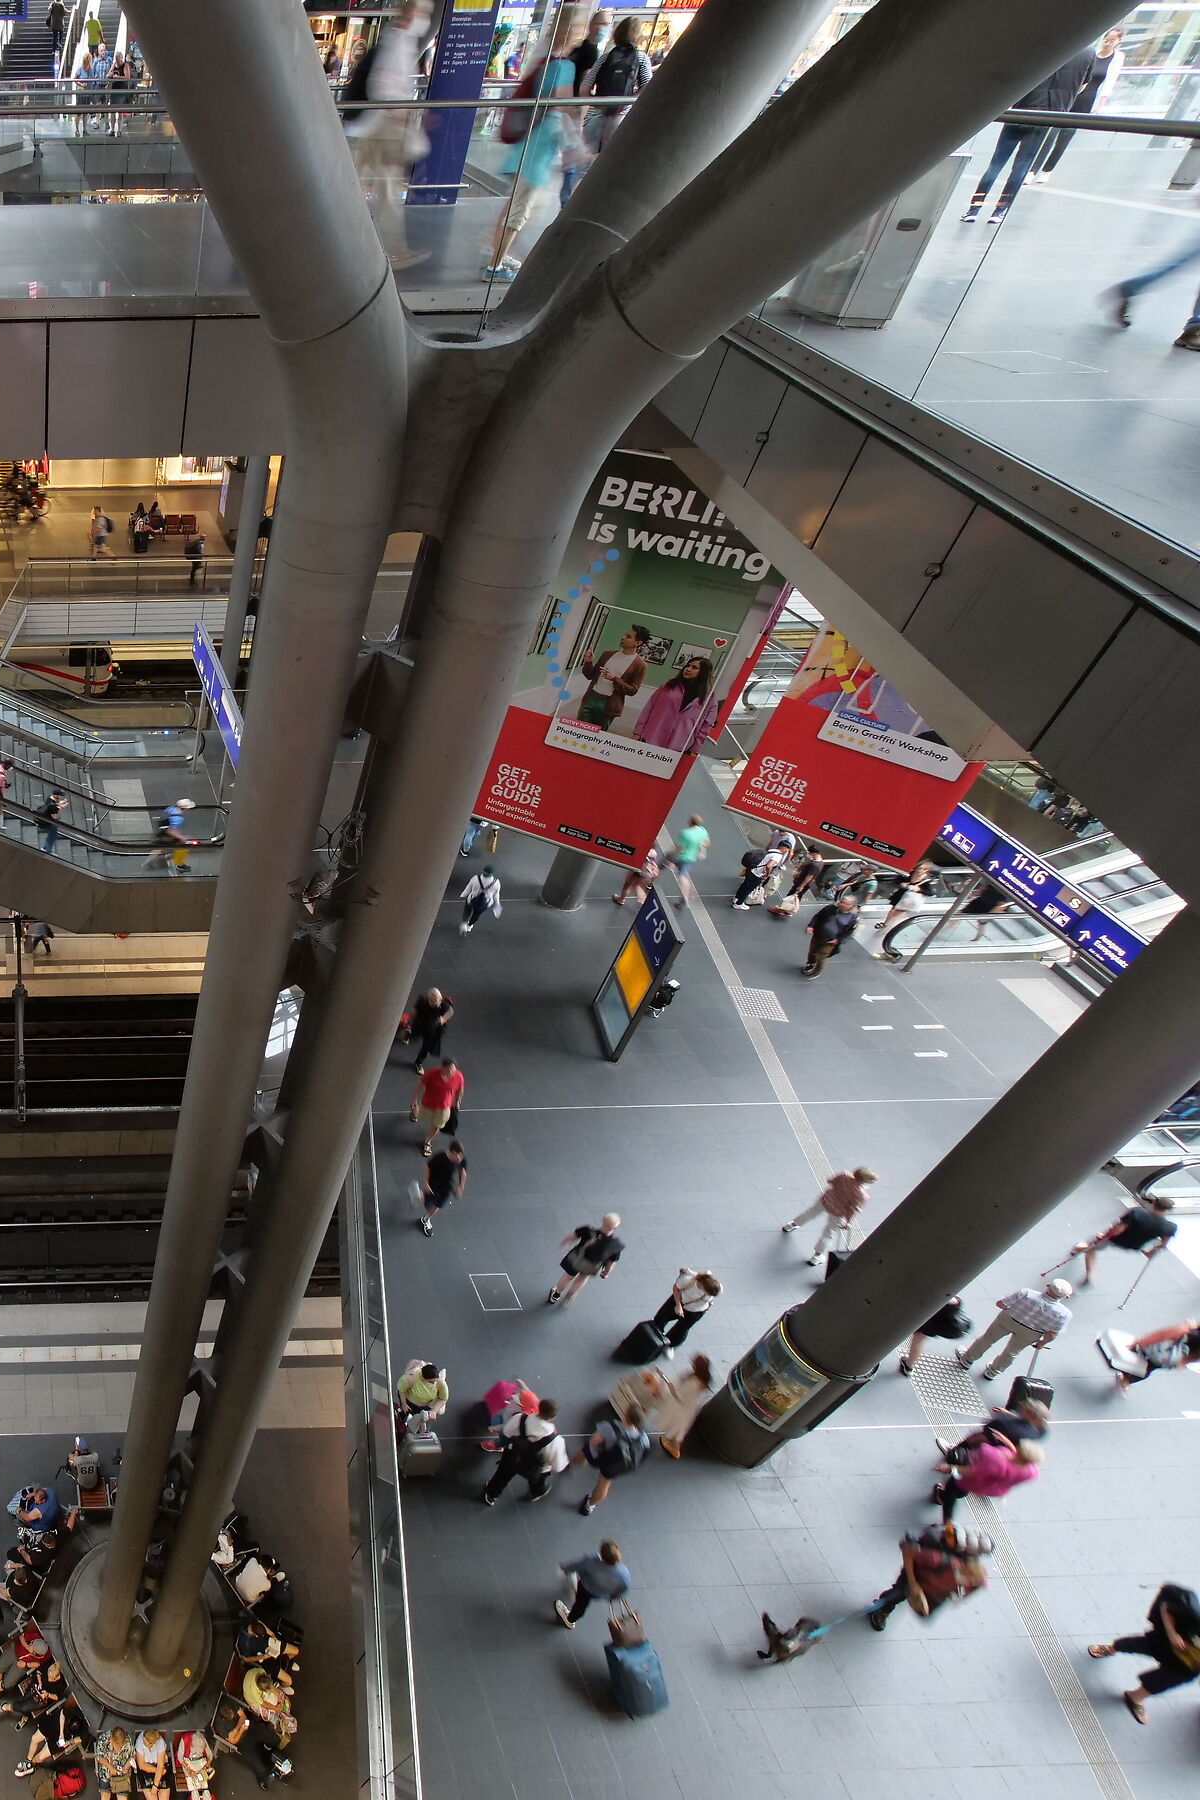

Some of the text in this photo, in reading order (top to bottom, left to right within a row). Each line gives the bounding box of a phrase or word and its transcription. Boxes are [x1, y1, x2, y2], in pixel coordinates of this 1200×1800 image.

[586, 512, 618, 544] is
[627, 528, 772, 582] waiting
[562, 718, 599, 731] ENTRY TICKET
[840, 713, 887, 730] LOCAL CULTURE
[556, 726, 602, 744] Photography
[603, 739, 636, 754] Museum
[645, 751, 673, 764] Exhibit
[599, 749, 610, 757] 4.6
[832, 720, 949, 762] Berlin Graffiti Workshop
[498, 763, 531, 781] GET
[761, 756, 798, 775] GET
[496, 773, 542, 797] YOUR
[750, 777, 805, 804] GUIDE
[759, 766, 808, 792] YOUR
[487, 797, 536, 818] Unforgettable
[491, 784, 541, 808] GUIDE
[745, 789, 797, 813] Unforgettable
[485, 804, 547, 829] travel experiences
[741, 796, 808, 825] travel experiences
[828, 828, 840, 836] App
[840, 831, 854, 840] Store
[606, 842, 621, 851] Google
[872, 843, 890, 853] Google
[890, 849, 901, 857] Play
[1012, 853, 1049, 885] 11-16
[1001, 868, 1035, 895] Reisezentrum
[1069, 897, 1081, 909] S
[645, 898, 666, 944] 7-8
[1093, 939, 1129, 969] Europaplatz
[1099, 934, 1126, 957] Ausgang
[80, 1466, 94, 1475] 68
